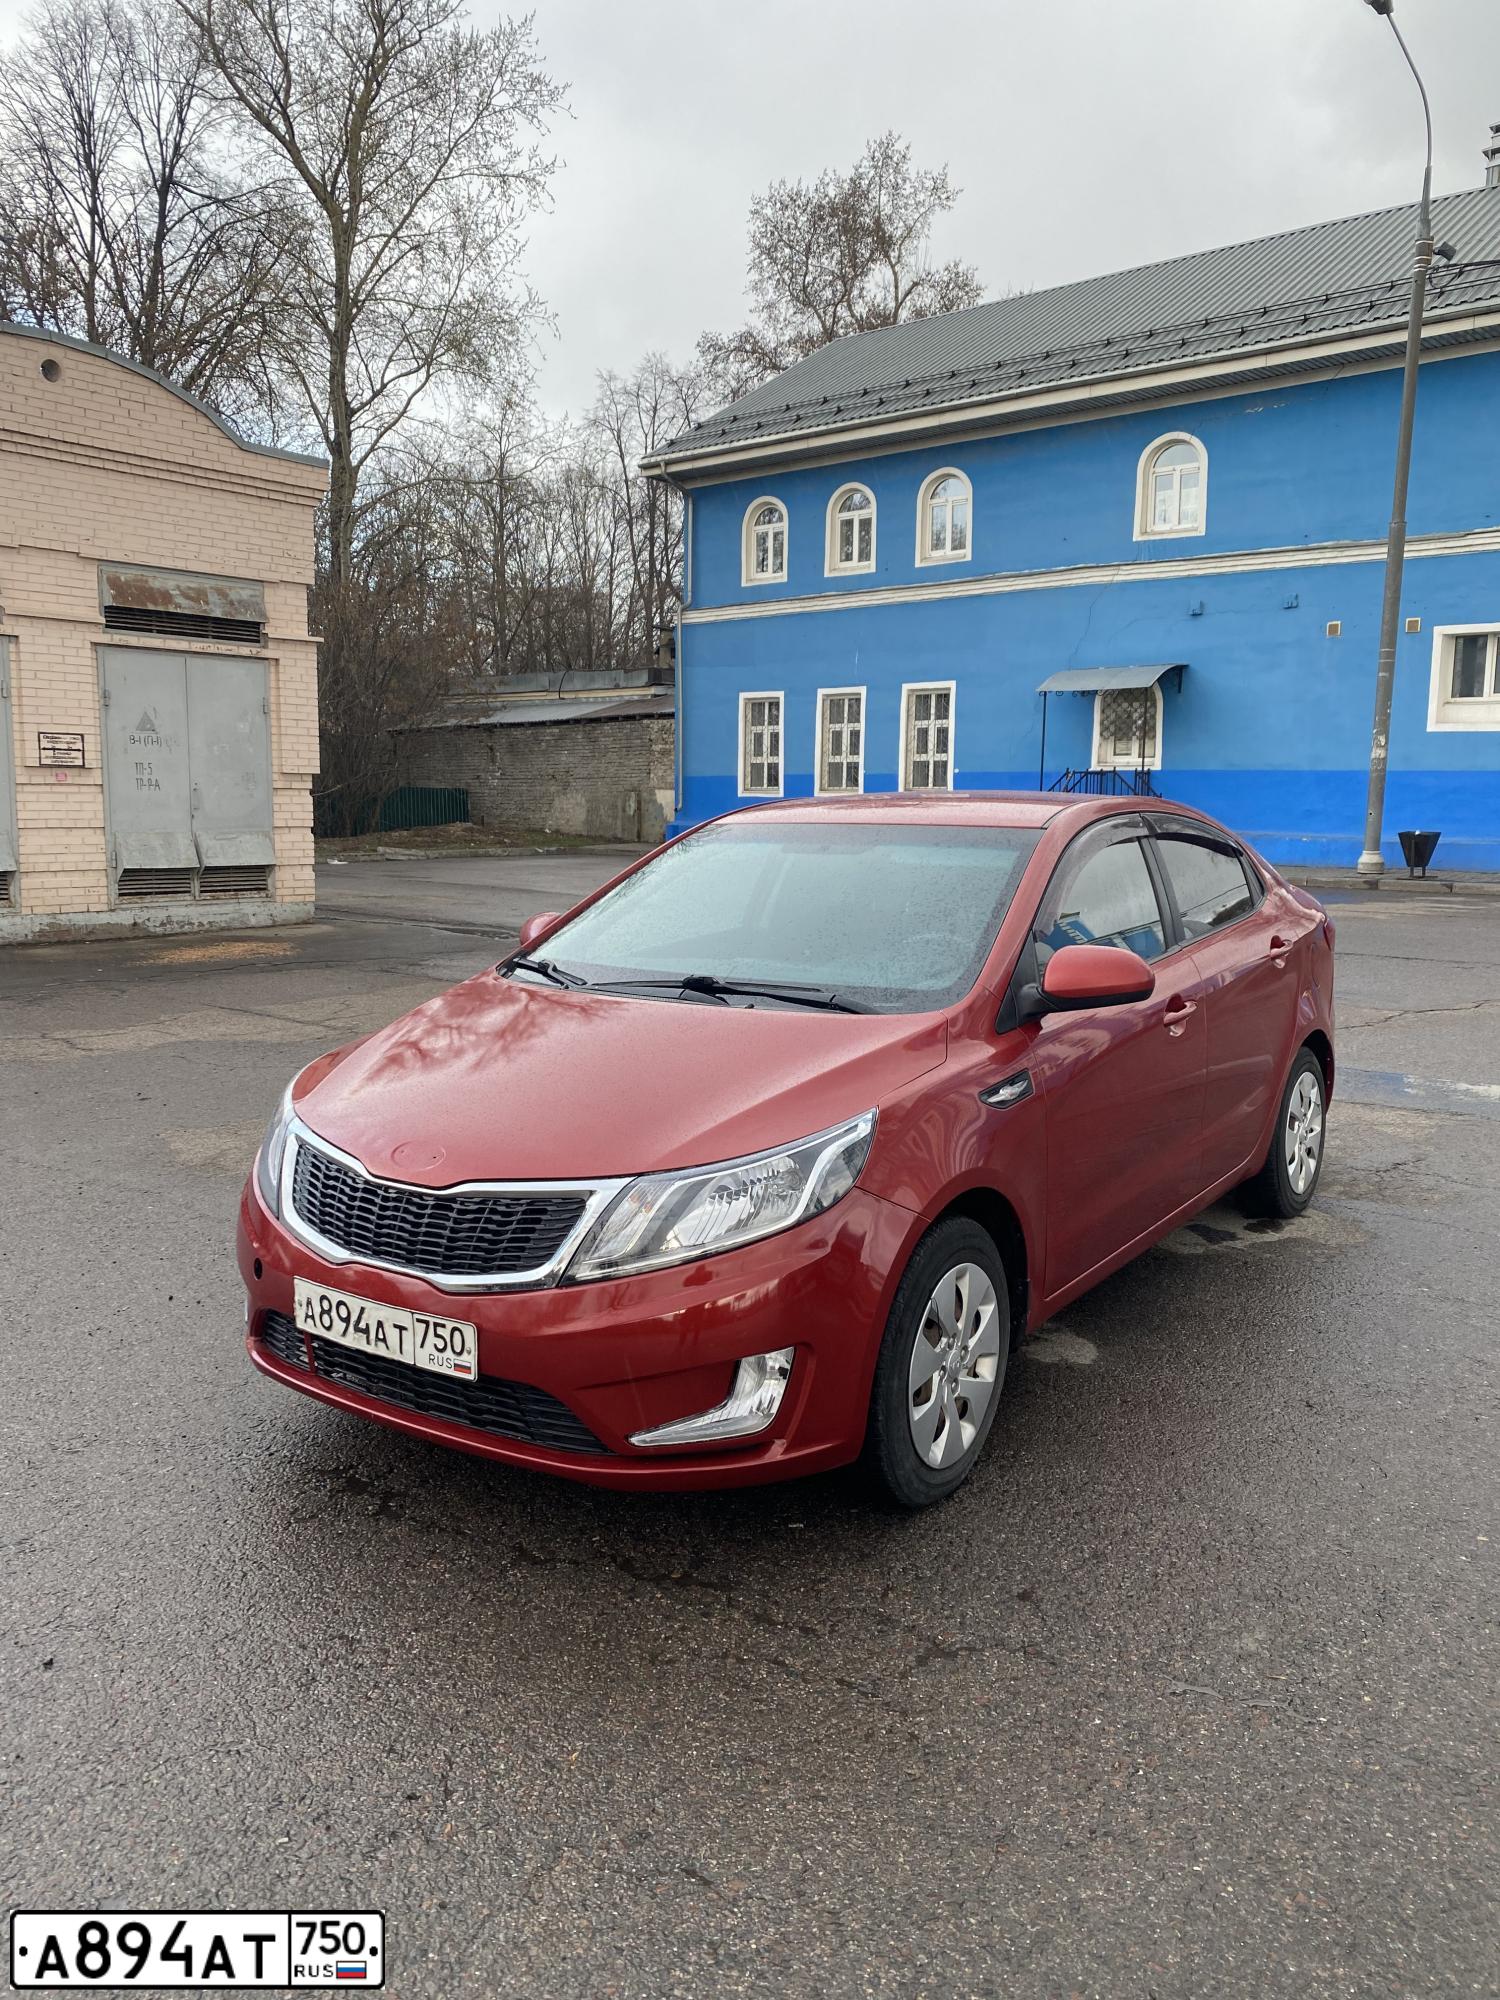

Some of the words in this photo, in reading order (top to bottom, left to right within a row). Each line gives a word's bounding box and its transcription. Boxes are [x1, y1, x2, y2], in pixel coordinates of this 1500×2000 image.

[304, 1294, 408, 1355] А894АТ
[416, 1317, 466, 1356] 750
[428, 1353, 453, 1369] RUS
